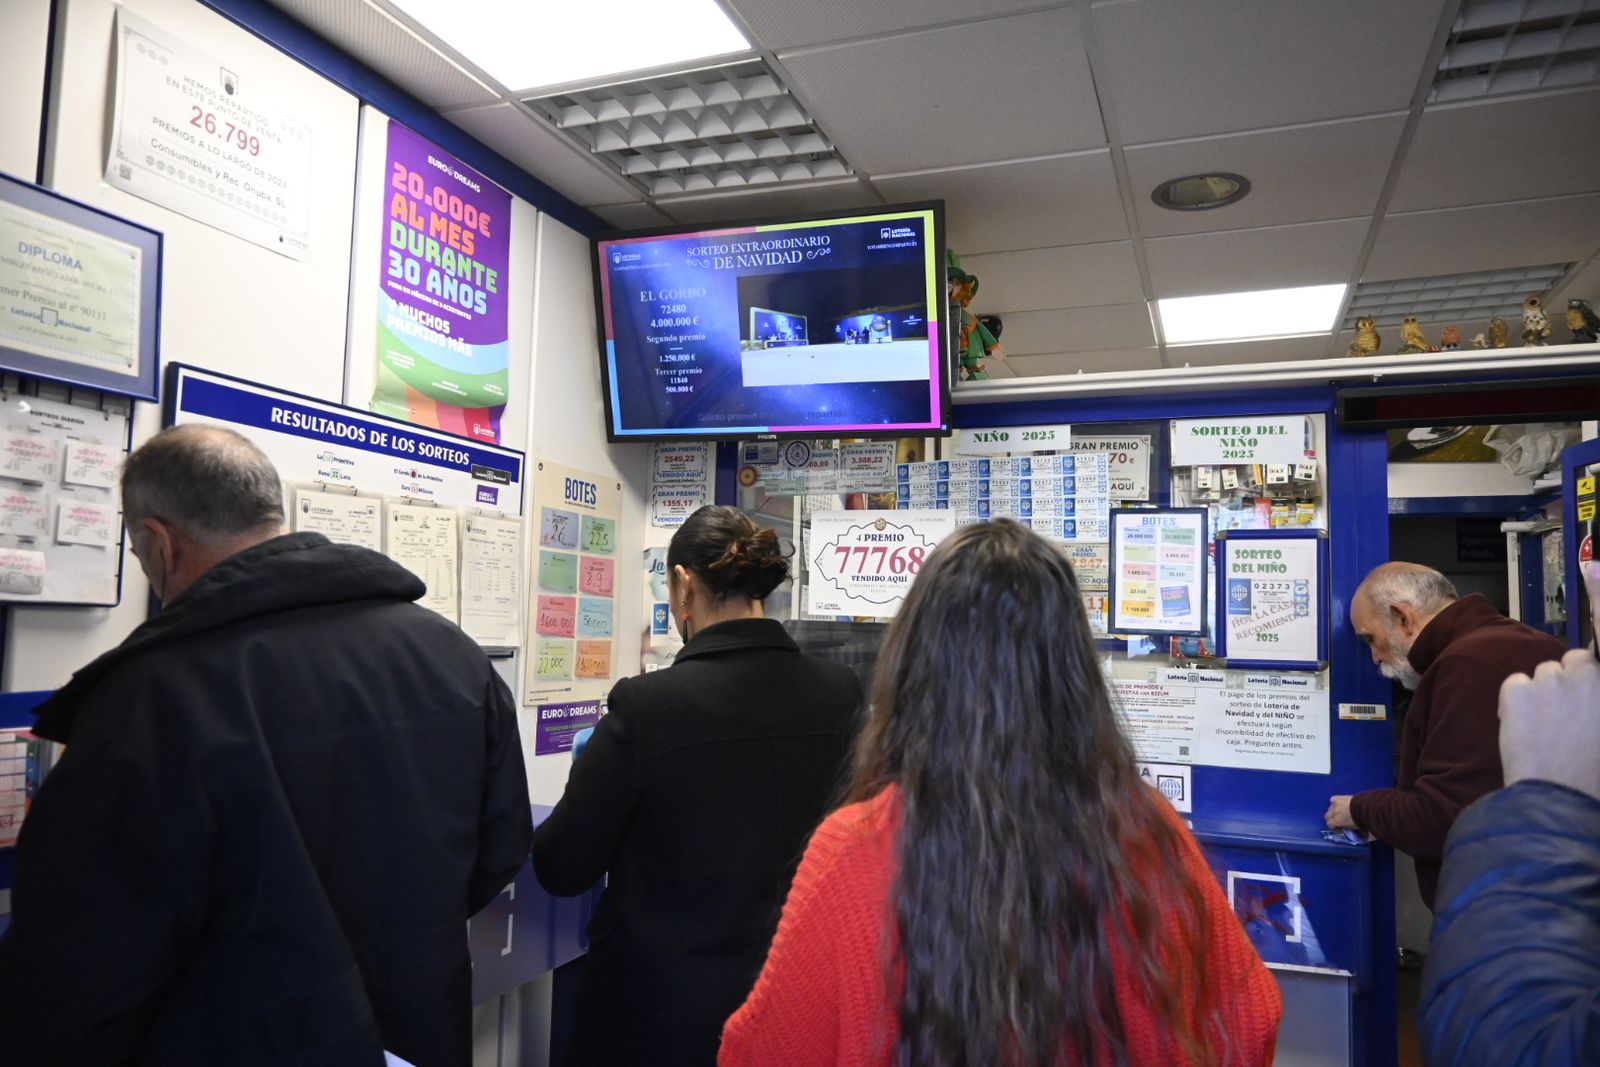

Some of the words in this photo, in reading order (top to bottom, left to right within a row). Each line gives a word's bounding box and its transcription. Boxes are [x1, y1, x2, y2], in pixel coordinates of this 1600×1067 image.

[190, 105, 260, 157] 26.799
[152, 117, 196, 145] PREMIOS
[199, 140, 205, 149] A
[208, 144, 220, 156] LO
[254, 166, 267, 180] DE
[152, 138, 213, 175] Consumibles
[216, 168, 221, 180] y
[428, 155, 448, 174] EURO
[454, 171, 481, 193] DREAMS
[392, 161, 492, 239] 20.000€
[390, 192, 425, 232] AL
[429, 212, 475, 256] MES
[686, 243, 729, 257] SORTEO
[730, 234, 830, 254] EXTRAORDINARIO
[18, 241, 84, 272] DIPLOMA
[390, 220, 498, 295] DURANTE
[714, 254, 735, 270] DE
[736, 250, 803, 268] NAVIDAD
[388, 248, 421, 287] 30
[426, 266, 488, 315] AÑOS
[640, 291, 657, 303] EL
[660, 286, 707, 301] GORDO
[660, 304, 687, 315] 72480
[399, 302, 451, 335] MUCHOS
[650, 317, 691, 328] 4.000.000
[693, 316, 699, 326] €
[646, 334, 678, 344] Segundo
[679, 333, 706, 343] premio
[659, 354, 691, 363] 1.250.000
[655, 368, 677, 376] Tercer
[678, 367, 703, 376] premio
[972, 430, 1010, 443] NIÑO
[1022, 430, 1056, 442] 2025
[1191, 426, 1252, 436] SORTEO
[1256, 425, 1288, 435] DEL
[271, 407, 367, 444] RESULTADOS
[370, 430, 388, 448] DE
[392, 435, 415, 454] LOS
[418, 441, 470, 470] SORTEOS
[1220, 436, 1258, 448] NIÑO
[1100, 442, 1139, 450] PREMIO
[1222, 450, 1255, 459] 2025
[658, 472, 686, 480] VENDIDO
[565, 477, 597, 506] BOTES
[1110, 482, 1135, 491] AQUÍ
[656, 516, 684, 524] VENDIDO
[1142, 516, 1177, 527] BOTES
[864, 534, 905, 542] PREMIO
[834, 546, 926, 575] 77768
[1234, 549, 1282, 560] SORTEO
[1232, 563, 1255, 573] DEL
[1257, 561, 1288, 574] NIÑO
[1256, 610, 1268, 621] LA
[1256, 634, 1279, 642] 2025
[1200, 676, 1224, 685] Nacional
[1282, 679, 1308, 689] Nacional
[1228, 692, 1245, 700] pago
[1256, 692, 1267, 700] los
[1268, 694, 1298, 702] premios
[542, 708, 563, 720] EURO
[570, 705, 597, 718] DREAMS
[1225, 710, 1255, 718] Navidad
[1256, 712, 1261, 720] y
[1274, 712, 1295, 720] NIÑO
[1272, 722, 1293, 731] según
[1216, 728, 1264, 739] disponibilidad
[1265, 731, 1275, 739] de
[1276, 732, 1305, 741] efectivo
[1306, 734, 1316, 742] en
[1226, 738, 1242, 747] caja.
[1244, 739, 1281, 749] Pregunten
[1282, 742, 1304, 750] antes.
